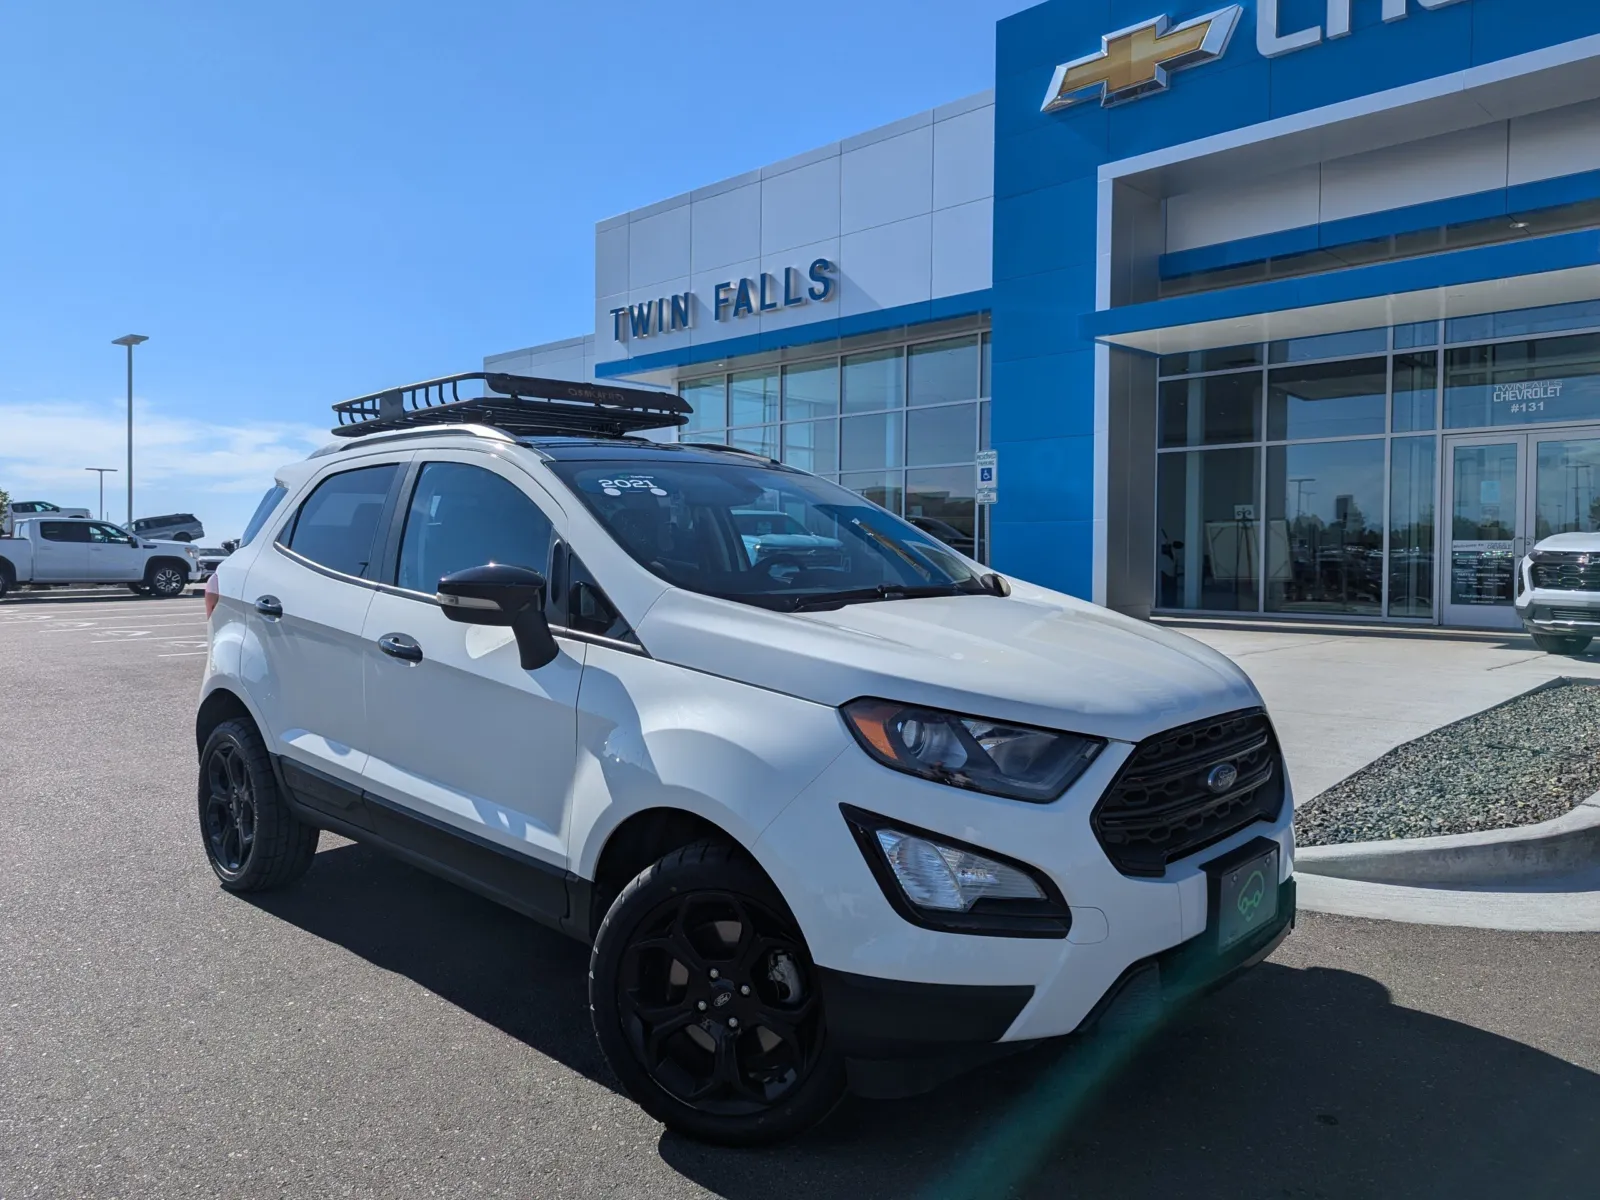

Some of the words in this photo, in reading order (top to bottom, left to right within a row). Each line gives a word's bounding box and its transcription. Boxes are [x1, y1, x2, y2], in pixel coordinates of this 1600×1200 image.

[610, 291, 693, 343] TWIN
[715, 258, 836, 322] FALLS
[1493, 386, 1562, 402] CHEVROLET
[1510, 401, 1544, 413] #131
[598, 479, 658, 488] 2021
